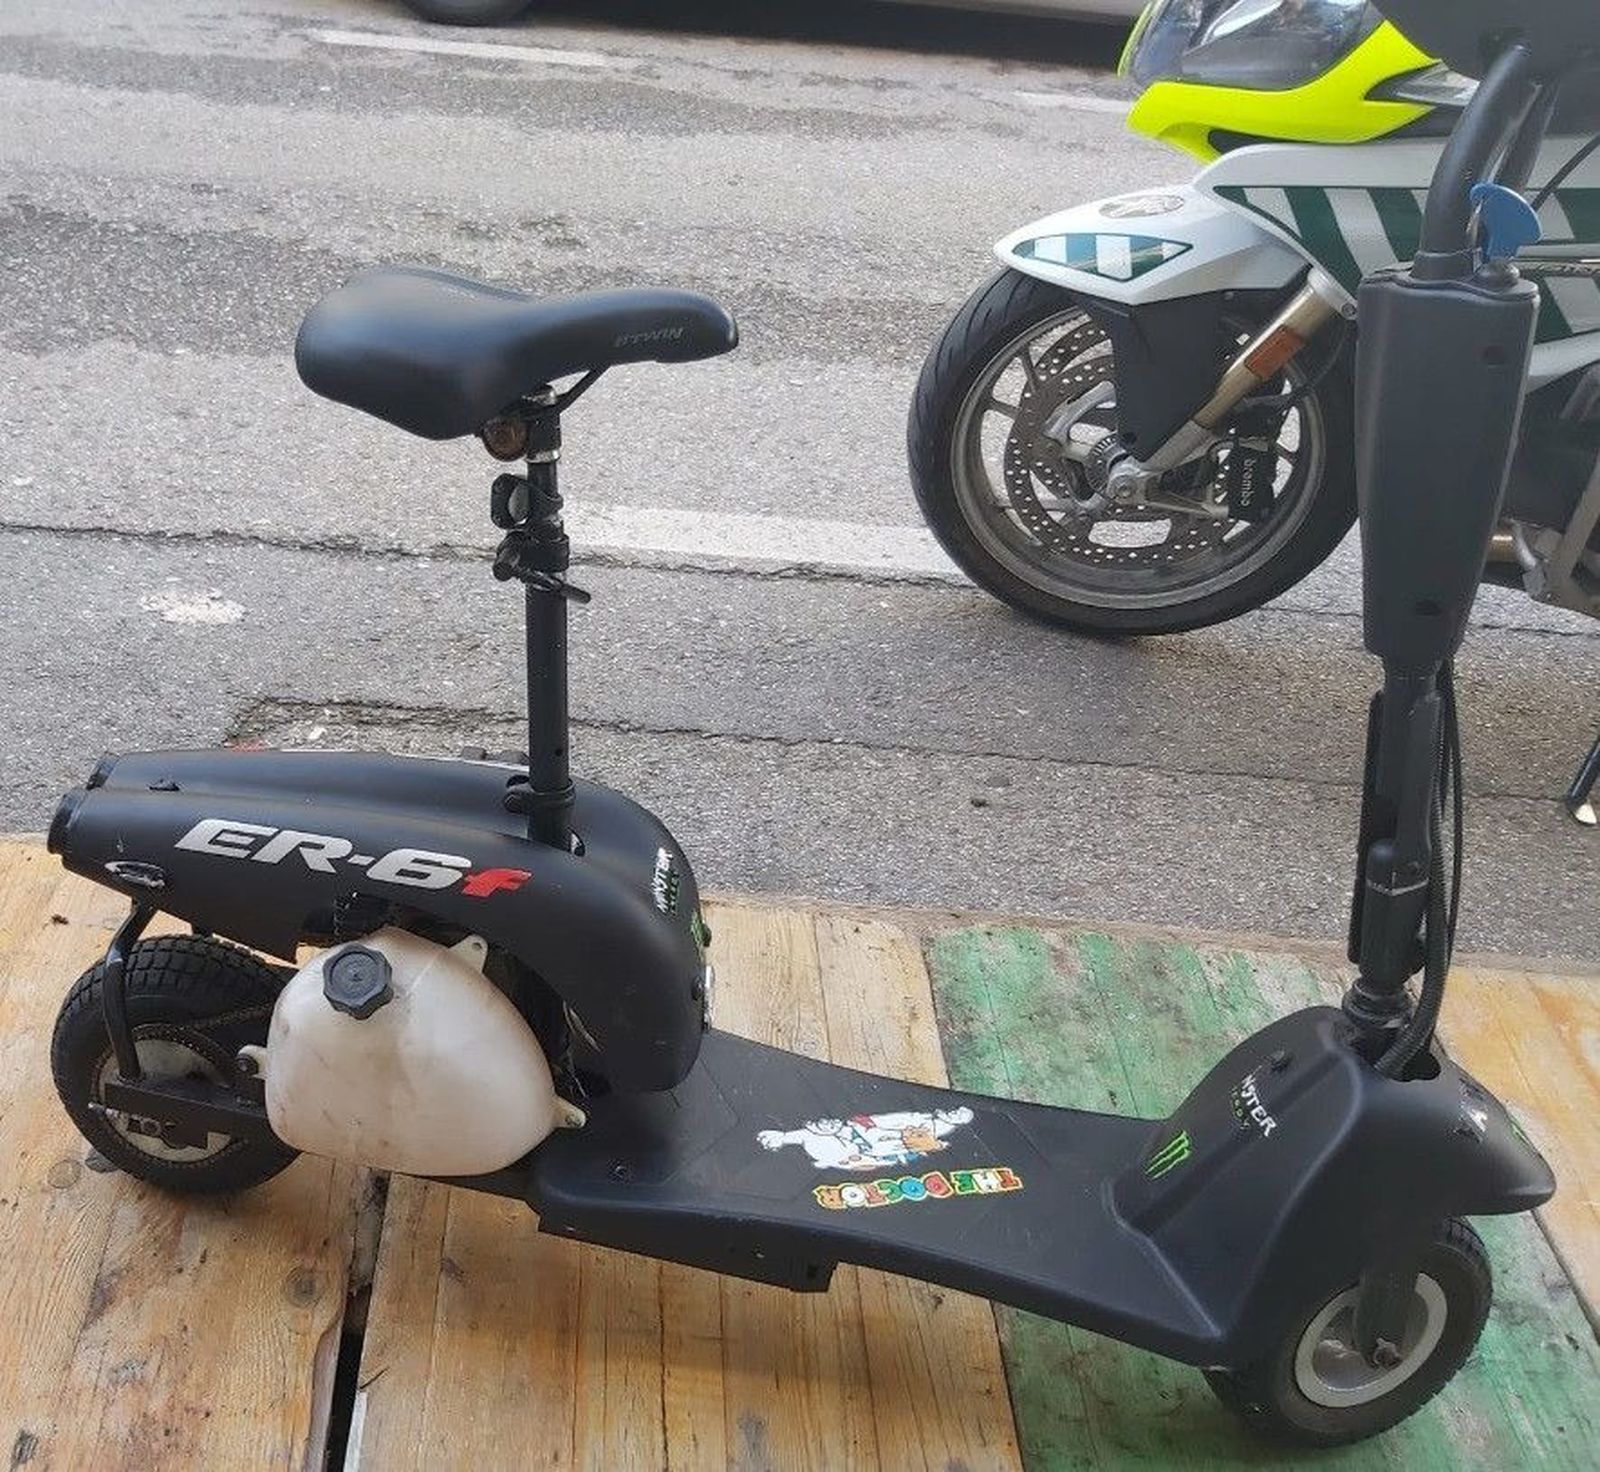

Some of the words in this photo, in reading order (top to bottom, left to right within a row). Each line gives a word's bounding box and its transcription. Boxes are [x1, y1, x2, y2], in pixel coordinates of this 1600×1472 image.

[174, 819, 532, 899] ER-6f
[813, 1171, 953, 1210] DOCTOR
[951, 1168, 1023, 1193] THE
